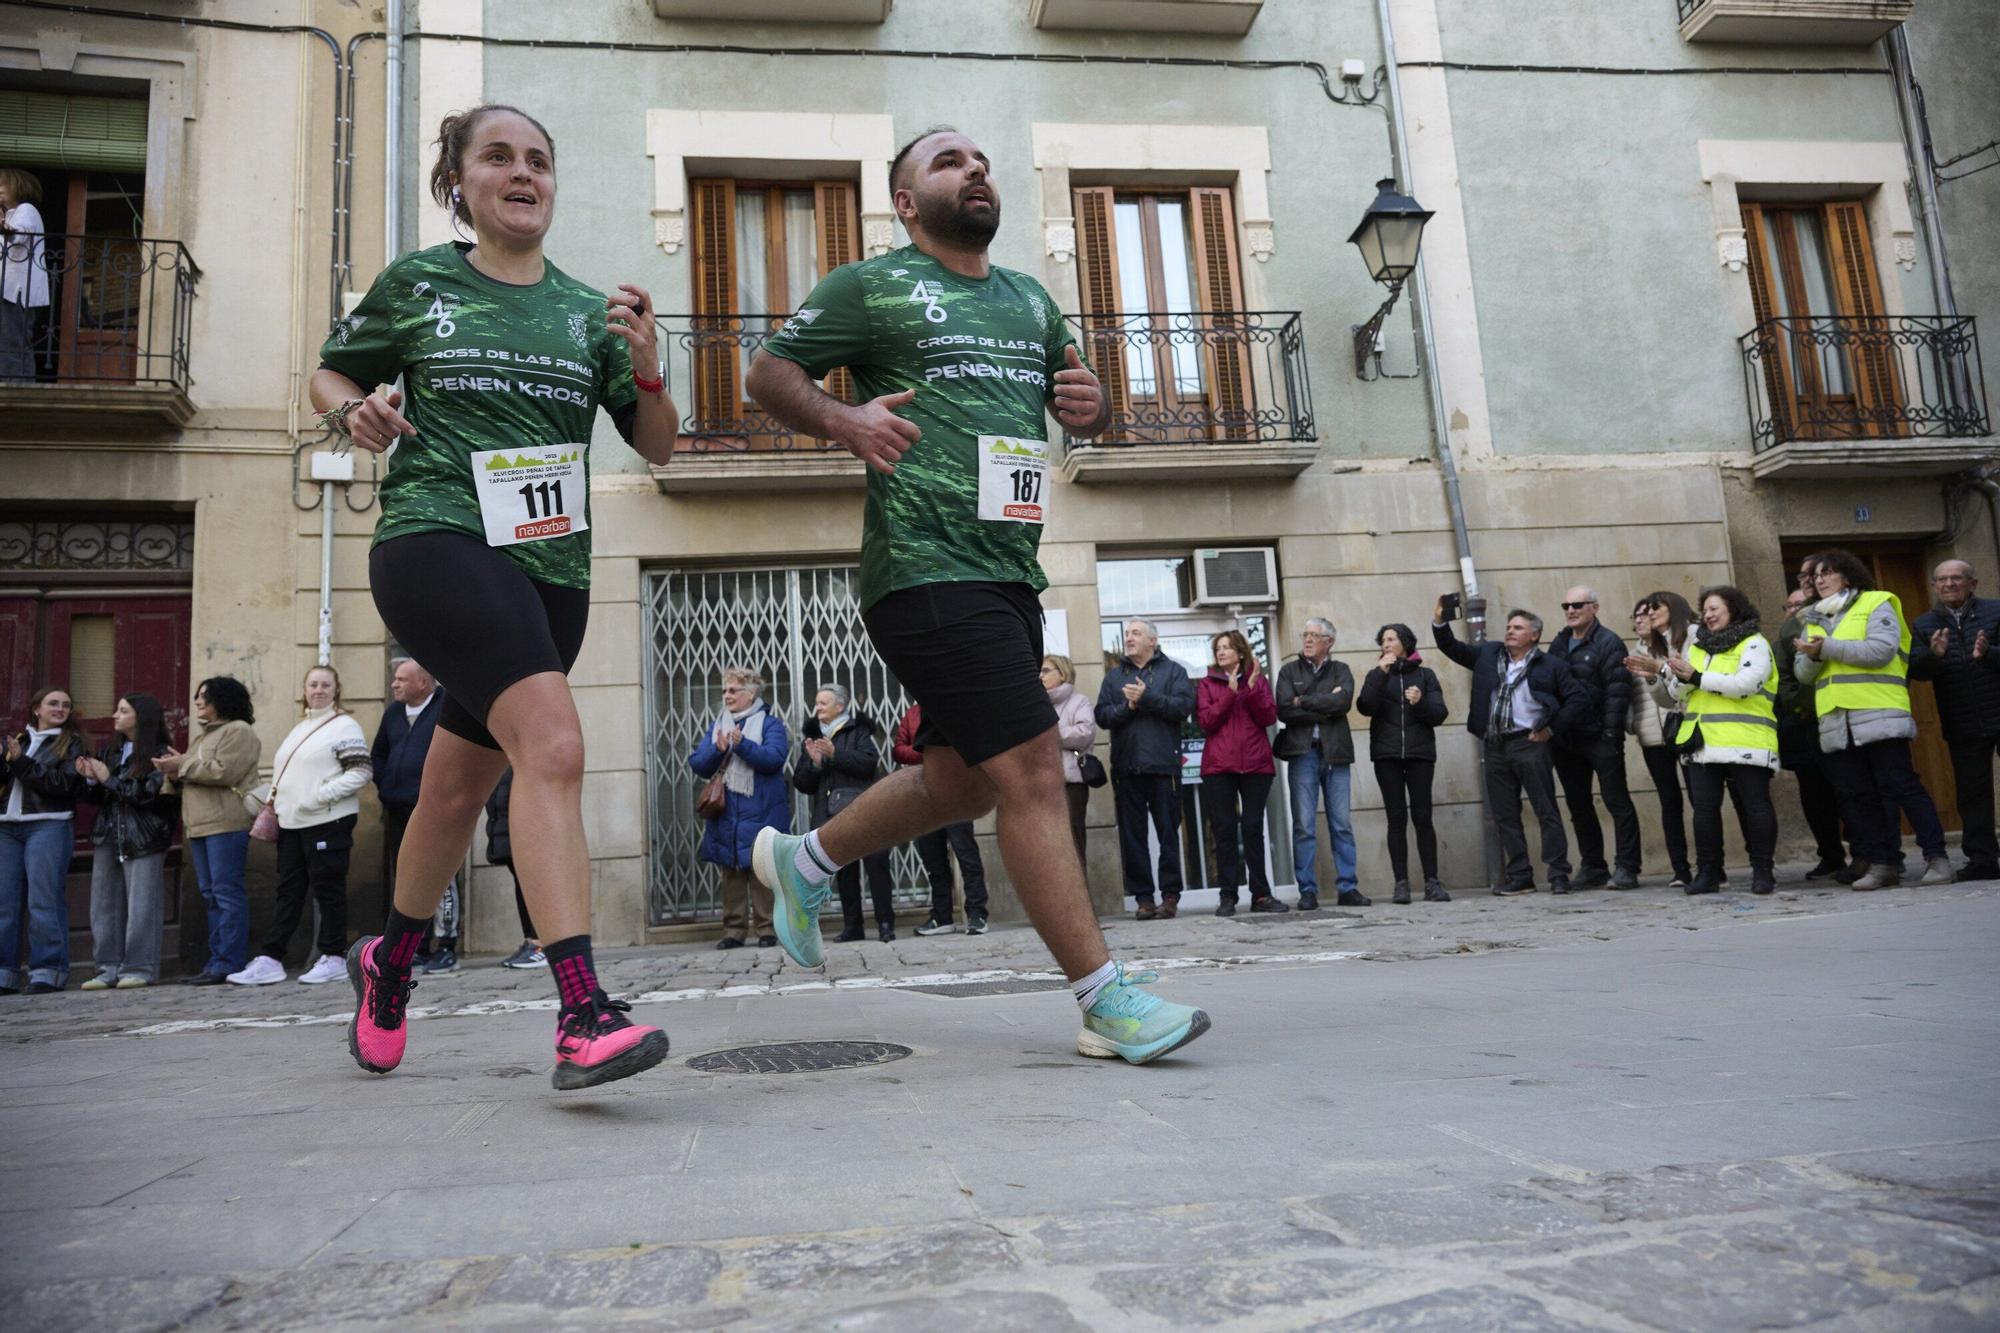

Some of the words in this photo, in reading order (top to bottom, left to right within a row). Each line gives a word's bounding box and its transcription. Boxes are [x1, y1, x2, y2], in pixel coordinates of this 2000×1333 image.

[916, 335, 976, 349] CROSS
[978, 337, 996, 347] DE
[999, 340, 1026, 349] LAS
[486, 350, 510, 359] DE
[514, 353, 552, 365] LAS
[925, 360, 1004, 383] PEÑEN
[1005, 367, 1046, 391] KROS
[430, 374, 511, 392] PEÑEN
[518, 381, 588, 408] KROSA
[489, 476, 523, 484] TAFALLAKO
[1010, 469, 1041, 503] 187
[518, 480, 563, 519] 111
[518, 520, 570, 537] navarban
